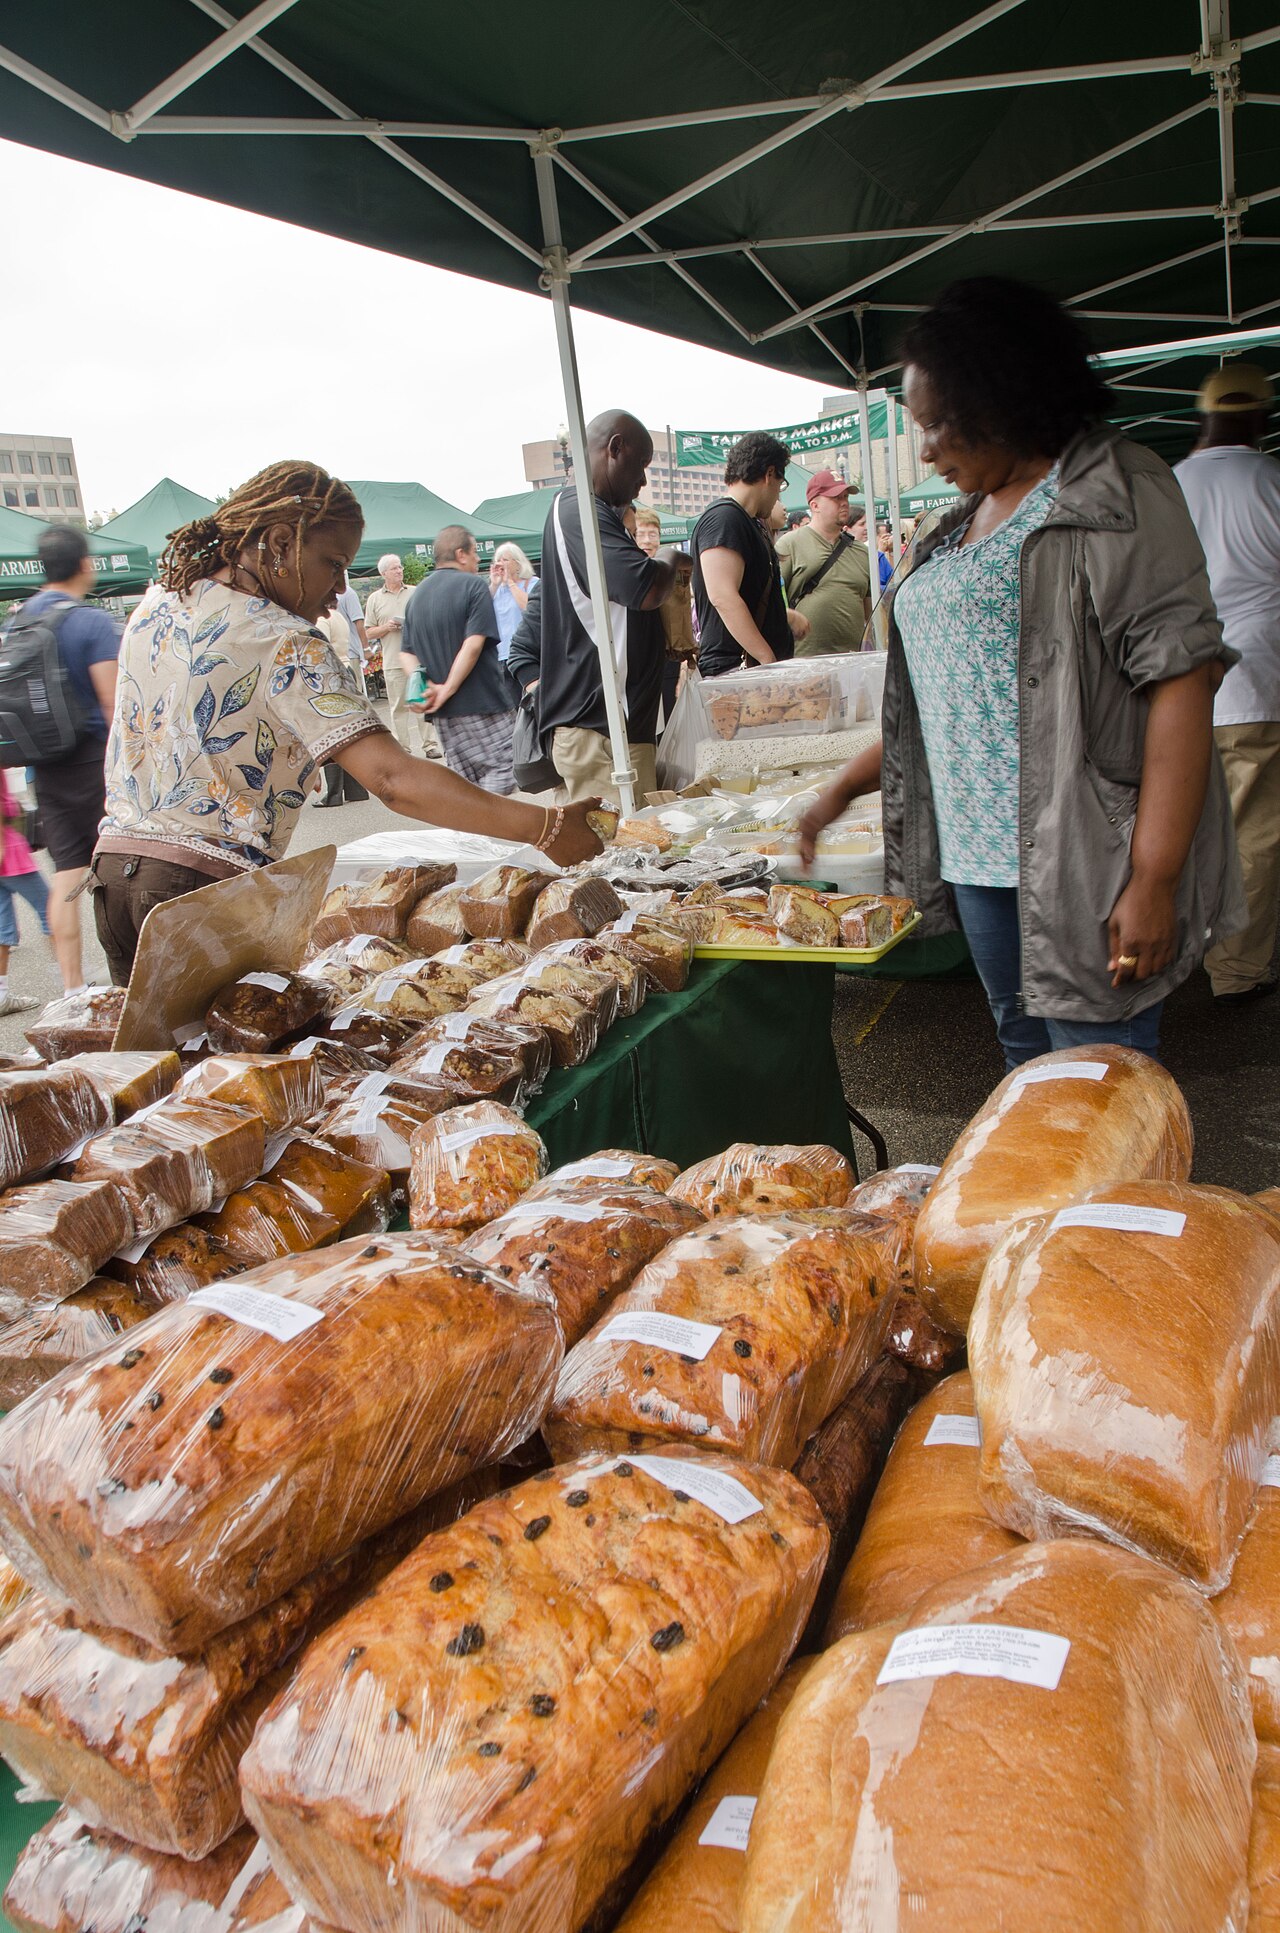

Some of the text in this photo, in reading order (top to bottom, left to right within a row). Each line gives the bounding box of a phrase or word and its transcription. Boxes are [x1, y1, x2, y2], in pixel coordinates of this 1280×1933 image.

[790, 413, 860, 439] MARKET
[805, 438, 821, 448] TO
[821, 436, 829, 445] 2
[830, 432, 853, 443] P.M.
[926, 496, 961, 508] FARME
[0, 560, 46, 576] ARMER
